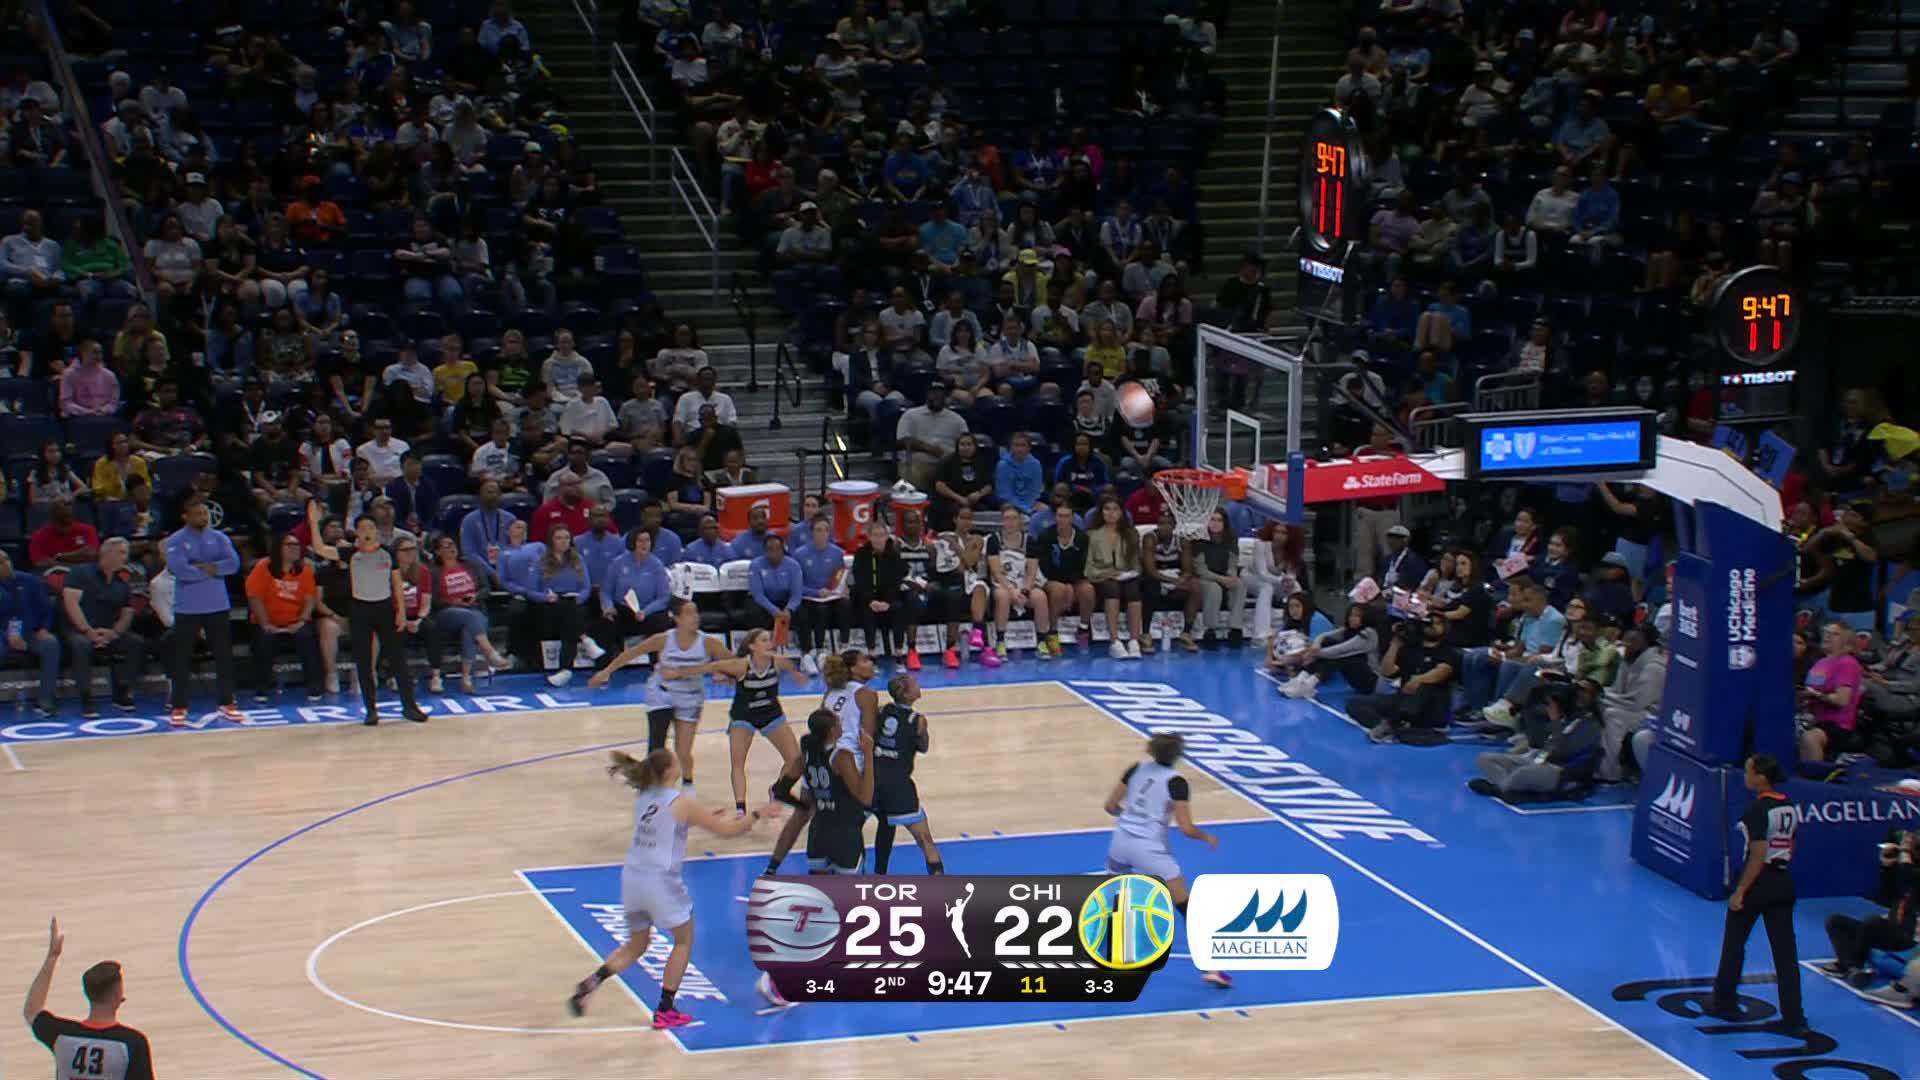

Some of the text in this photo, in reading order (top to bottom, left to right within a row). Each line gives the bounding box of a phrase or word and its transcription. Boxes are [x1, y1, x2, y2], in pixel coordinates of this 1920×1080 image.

[1319, 176, 1342, 238] 11
[1742, 293, 1791, 320] 9:47
[1749, 319, 1781, 352] 11
[1741, 369, 1797, 385] TISSOT
[853, 503, 871, 523] G
[1728, 568, 1742, 642] UChicago
[1742, 567, 1757, 641] Medicine
[882, 716, 899, 737] 9
[639, 803, 659, 823] 2
[71, 1045, 105, 1075] 43
